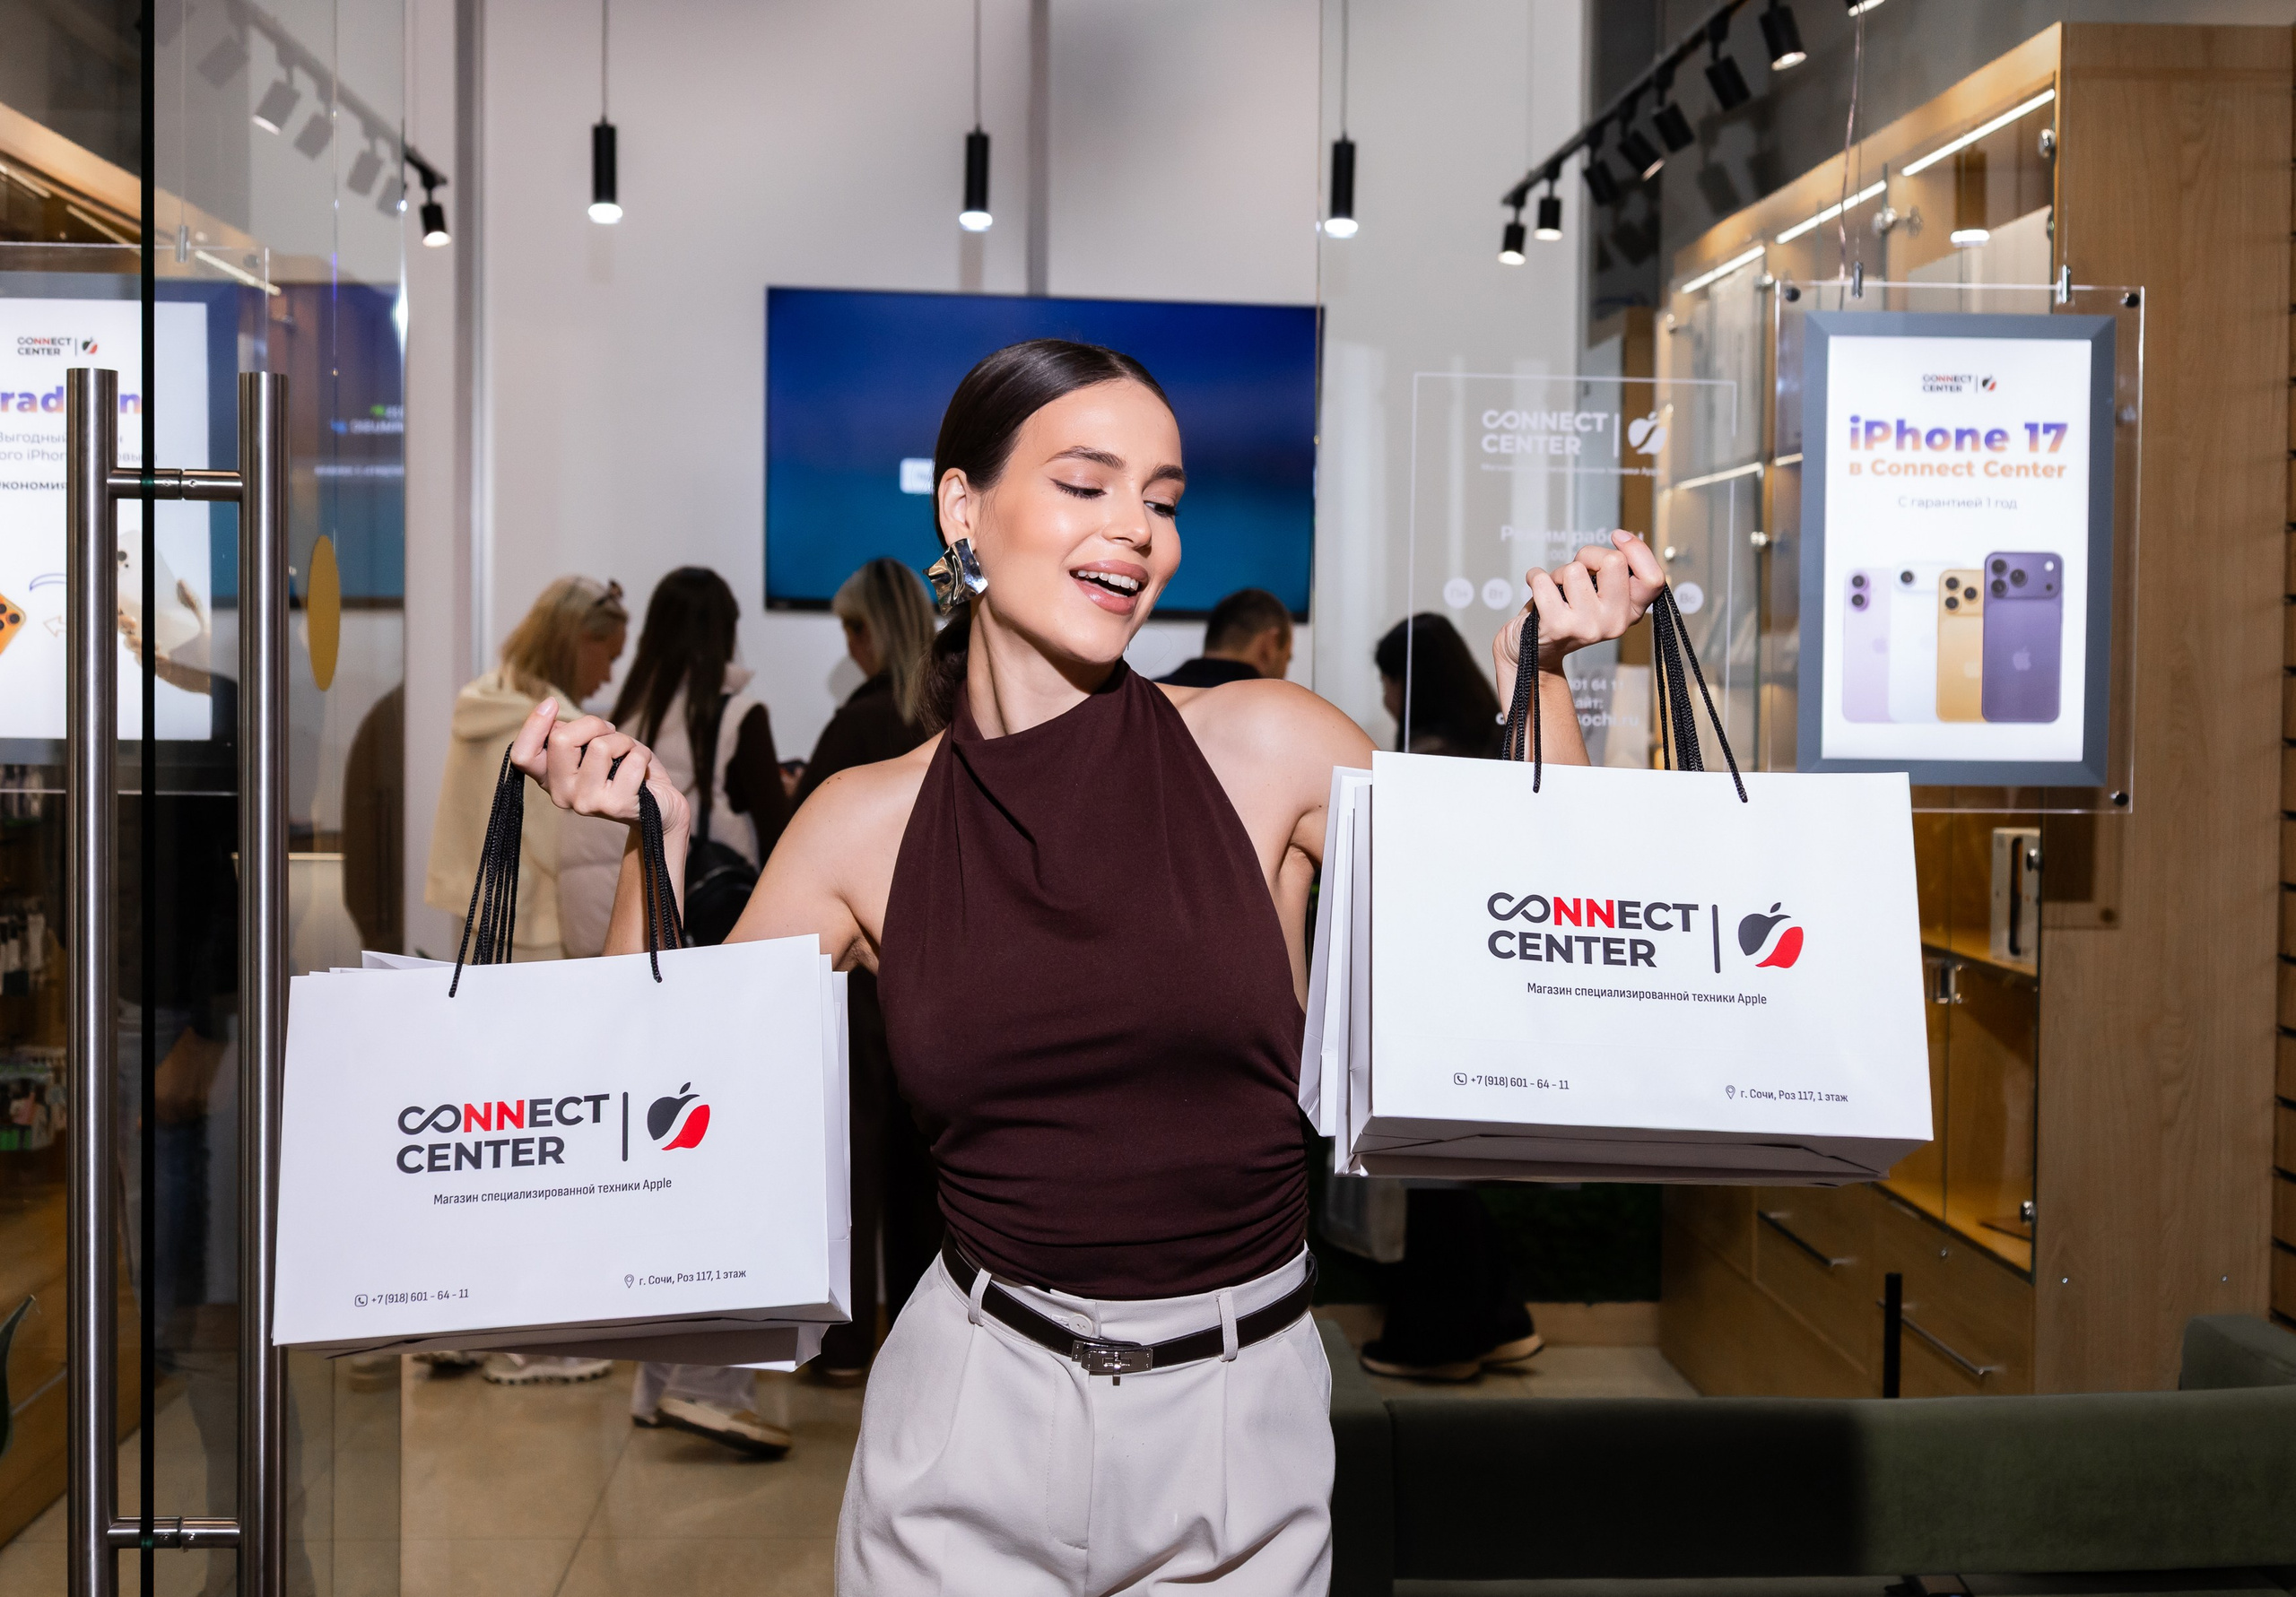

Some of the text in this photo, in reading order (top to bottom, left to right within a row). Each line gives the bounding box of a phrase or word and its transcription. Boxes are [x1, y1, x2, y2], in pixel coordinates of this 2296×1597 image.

[17, 336, 72, 346] CONNECT
[17, 347, 61, 355] CENTER
[1922, 374, 1972, 383] CONNECT
[1922, 384, 1962, 392] CENTER
[1482, 410, 1609, 432] CONNECT
[1481, 433, 1581, 455] CENTER
[1849, 415, 2068, 453] iPhone 17
[1871, 458, 1975, 477] Connect
[1983, 460, 2066, 478] Center
[1910, 497, 1983, 509] гарантией
[1995, 499, 2018, 509] год
[1487, 891, 1700, 933] CONNECT
[1487, 929, 1657, 968] CENTER
[1527, 983, 1767, 1006] Магазин специализированной техники Apple
[1471, 1076, 1482, 1084] +7
[1484, 1076, 1508, 1088] (918)
[1510, 1077, 1527, 1088] 601
[1537, 1079, 1549, 1089] 64
[1559, 1080, 1569, 1089] 11
[1741, 1089, 1848, 1102] г. Сочи, Роз 117, 1 этаж
[397, 1093, 610, 1135] CONNECT
[396, 1136, 565, 1174] CENTER
[433, 1177, 672, 1205] Магазин специализированной техники Apple
[639, 1271, 746, 1286] г. Сочи, Роз 117, 1 этаж
[371, 1295, 383, 1304] +7
[385, 1292, 408, 1305] (918)
[411, 1292, 428, 1302] 601
[438, 1290, 449, 1299] 64
[459, 1289, 469, 1298] 11
